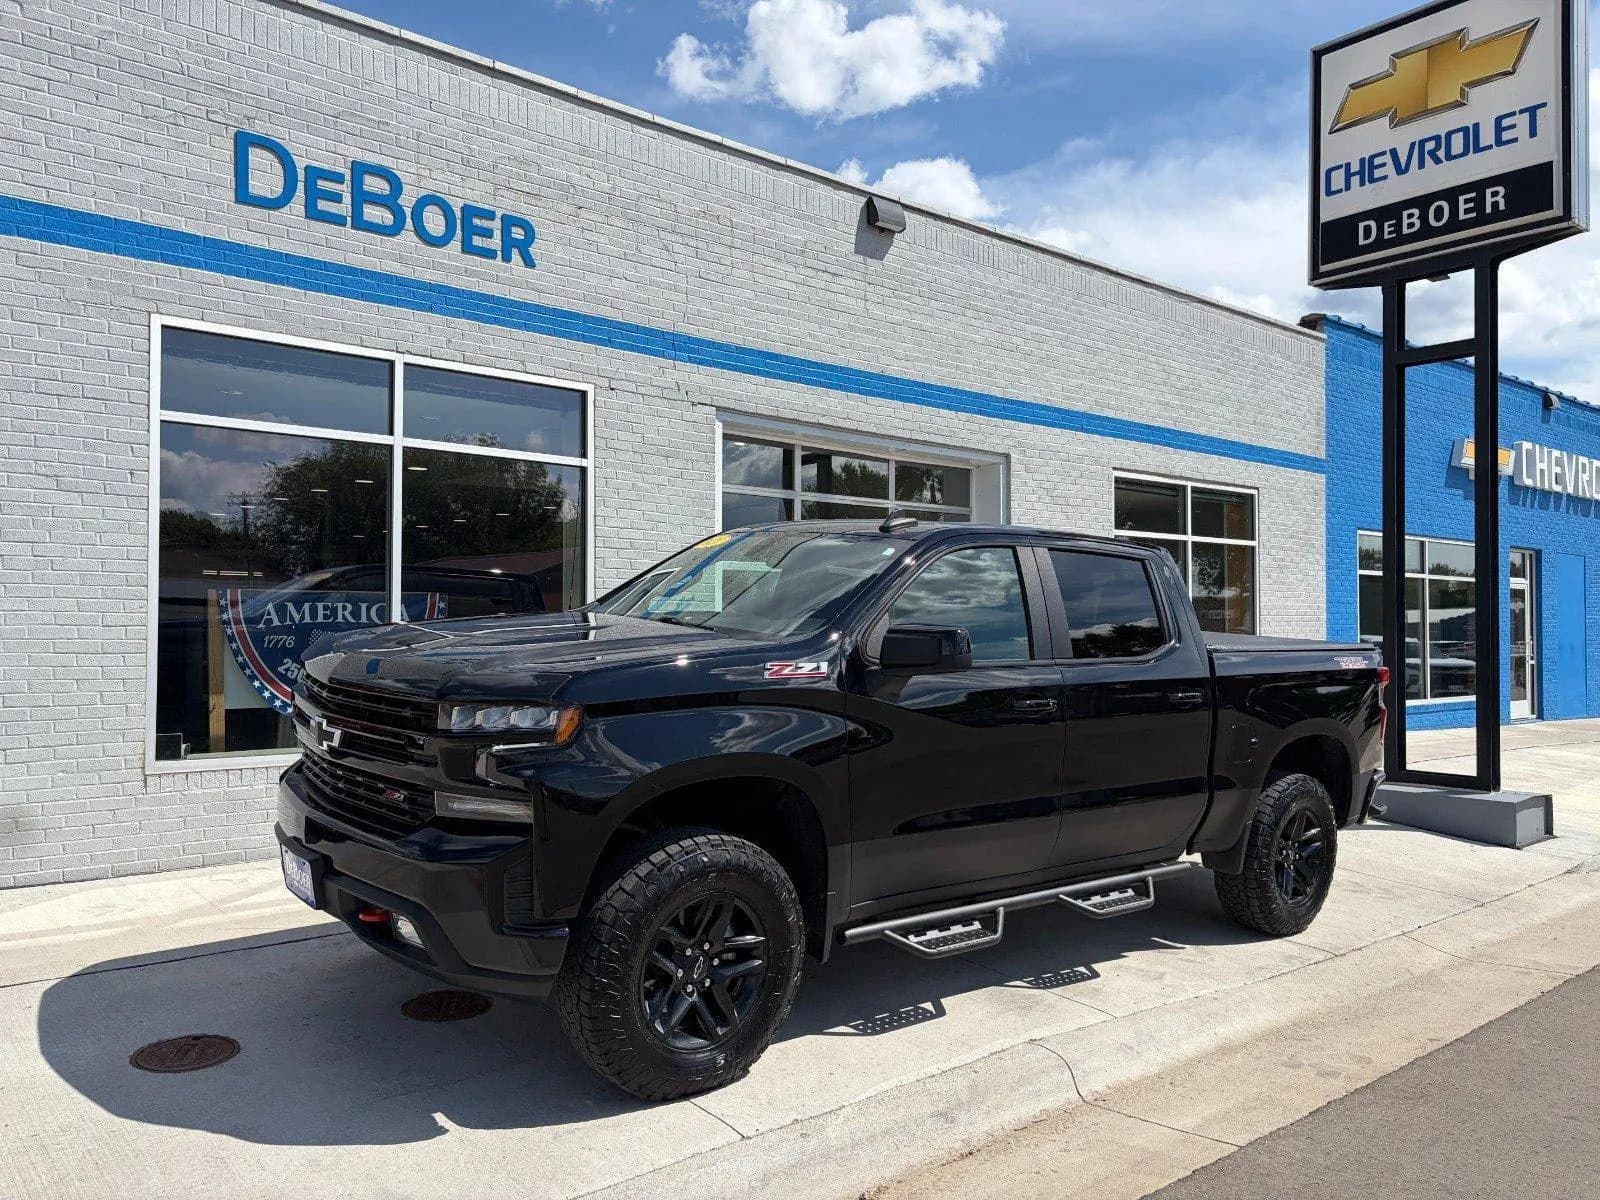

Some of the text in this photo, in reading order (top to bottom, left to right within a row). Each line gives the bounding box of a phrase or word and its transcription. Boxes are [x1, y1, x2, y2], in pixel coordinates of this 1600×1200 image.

[1324, 101, 1548, 197] CHEVROLET
[233, 129, 537, 269] DEBOER
[1358, 185, 1506, 246] DEBOER
[263, 635, 296, 649] 1776
[764, 661, 828, 679] Z71
